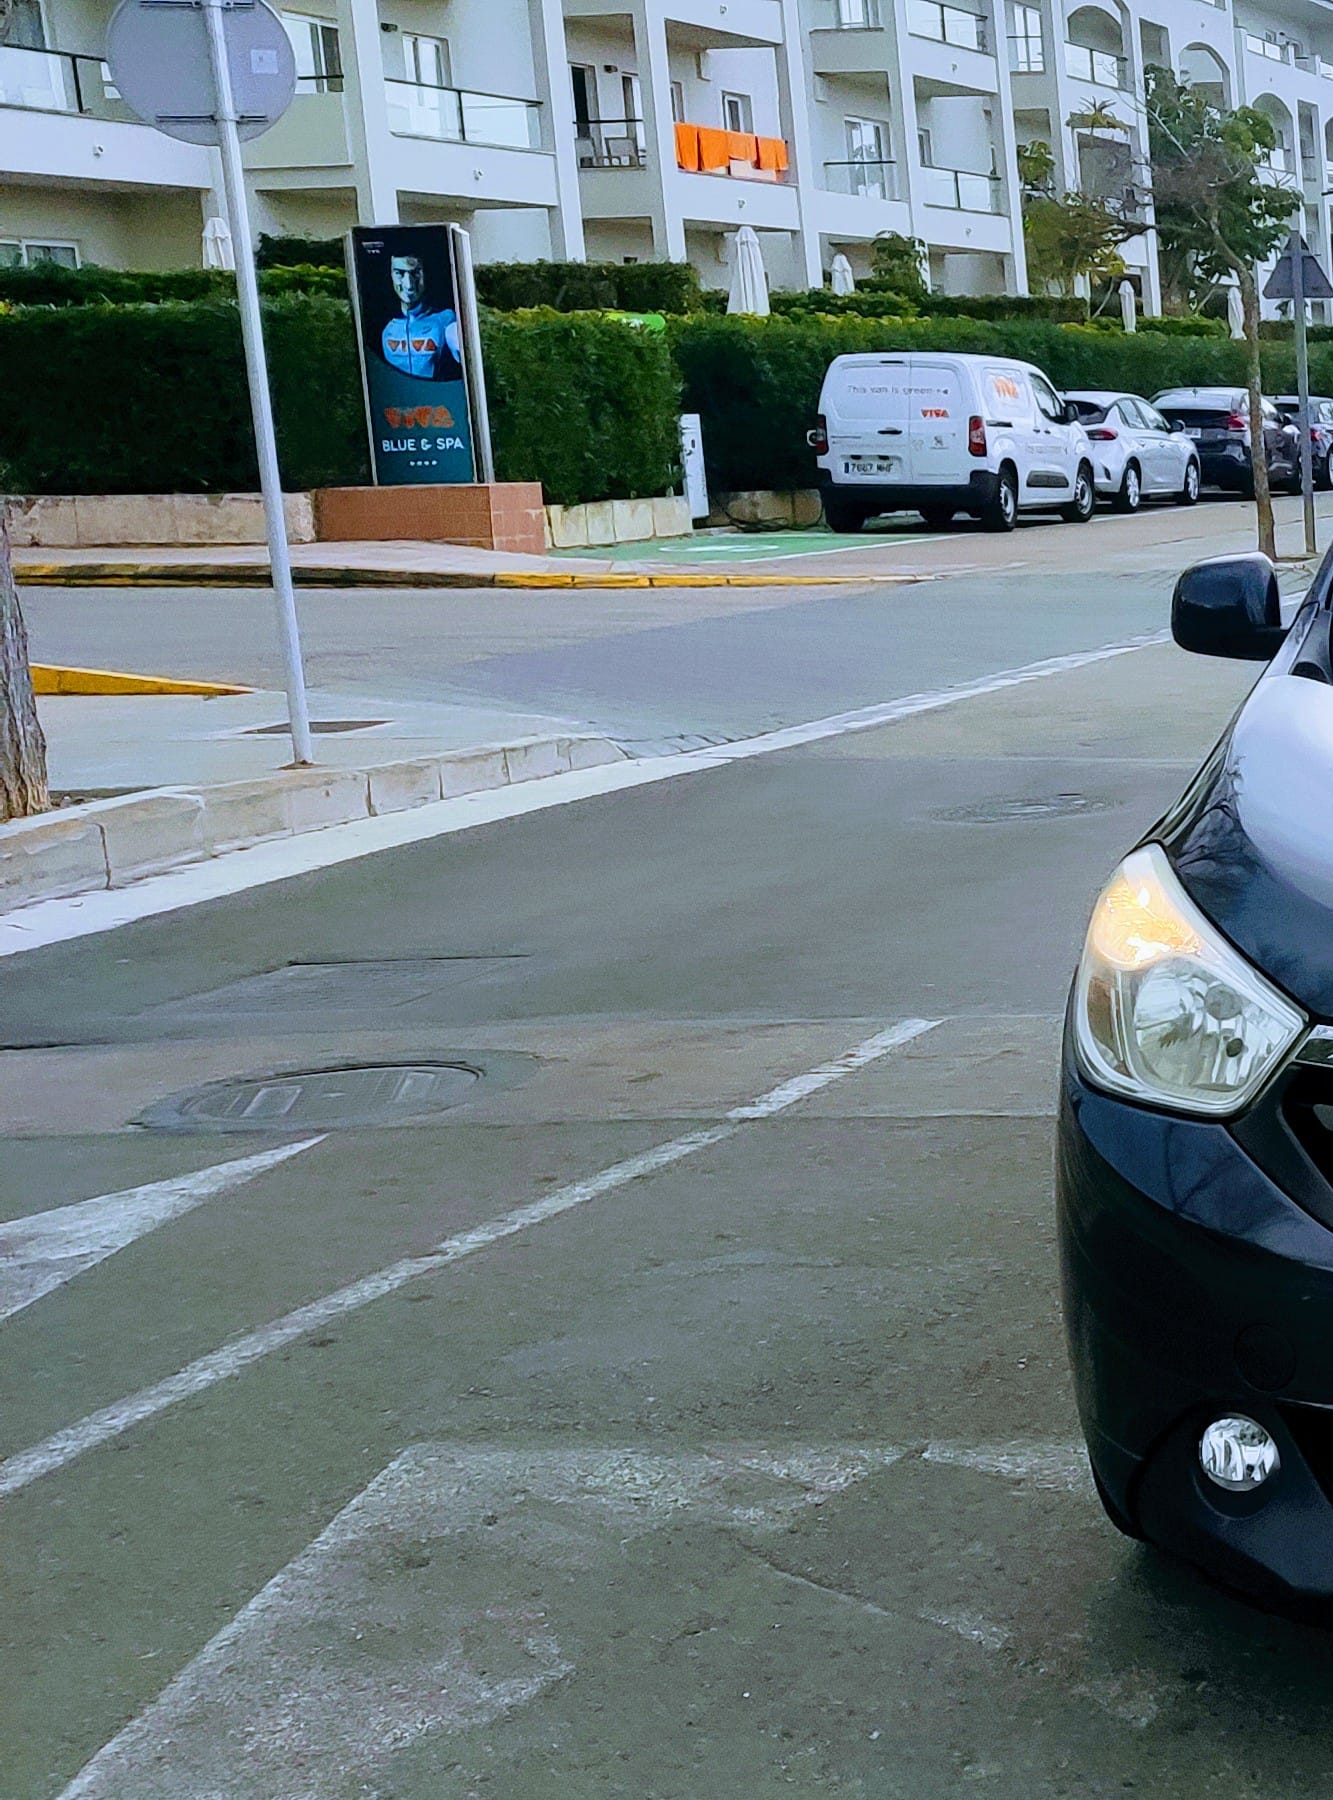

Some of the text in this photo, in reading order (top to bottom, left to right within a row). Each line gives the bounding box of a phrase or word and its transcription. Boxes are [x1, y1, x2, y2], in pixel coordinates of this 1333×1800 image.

[387, 338, 438, 353] VIVA
[870, 386, 888, 394] van
[891, 385, 900, 394] is
[920, 409, 950, 418] VIVA
[382, 437, 465, 452] BLUE & SPA
